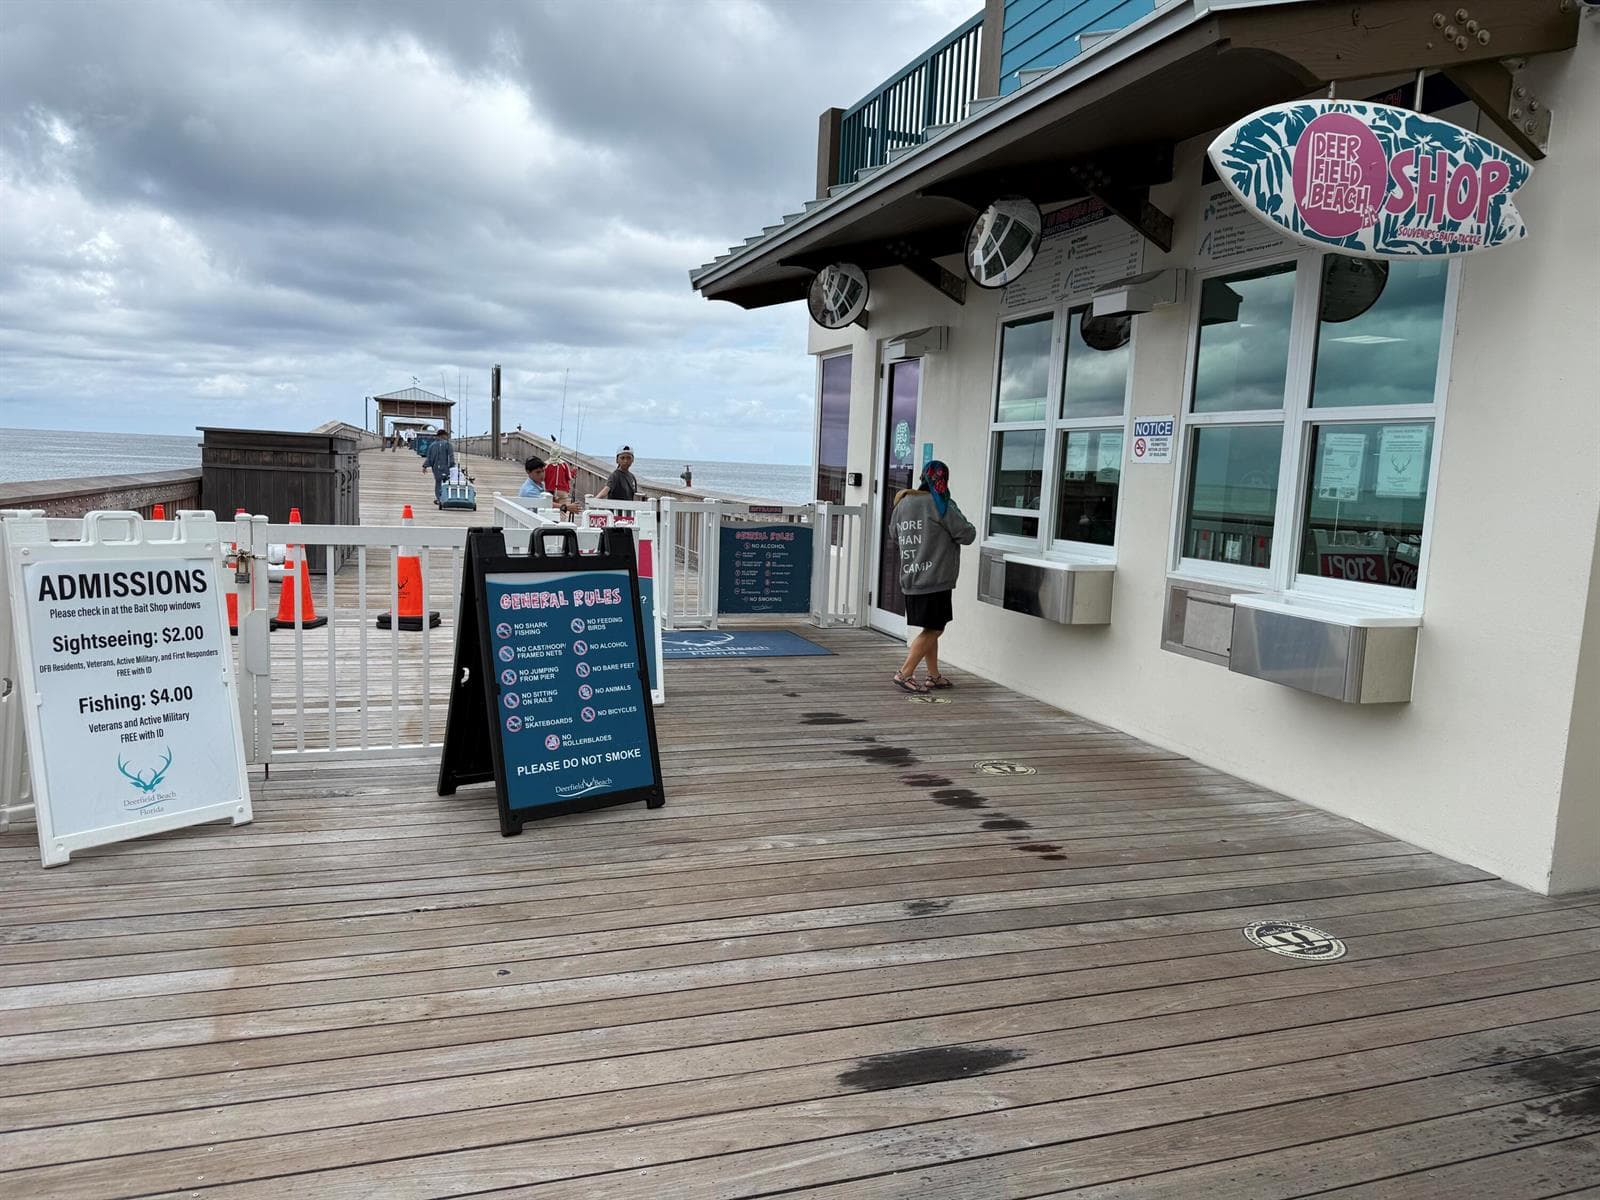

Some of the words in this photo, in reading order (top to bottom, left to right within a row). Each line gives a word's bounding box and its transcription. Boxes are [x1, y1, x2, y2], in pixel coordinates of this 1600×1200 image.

[1314, 132, 1361, 161] DEER
[1312, 158, 1362, 186] FIELD
[1384, 148, 1511, 224] SHOP
[1309, 182, 1370, 214] BEACH
[1135, 422, 1172, 435] NOTICE
[903, 561, 932, 573] CAMP
[38, 569, 208, 602] ADMISSIONS
[500, 590, 569, 610] GENERAL
[573, 588, 622, 607] RULES
[50, 608, 76, 619] Please
[78, 606, 101, 617] check
[102, 606, 110, 615] in
[112, 606, 119, 614] at
[120, 604, 133, 614] the
[134, 603, 149, 613] Bait
[150, 602, 168, 613] Shop
[170, 602, 201, 611] windows
[598, 616, 623, 624] FEEDING
[52, 630, 158, 655] Sightseeing:
[162, 626, 204, 644] $2.00
[53, 660, 86, 672] Residents,
[86, 658, 116, 669] Veterans,
[116, 656, 135, 666] Active
[136, 654, 160, 664] Military,
[161, 653, 172, 661] and
[186, 650, 218, 659] Responders
[117, 669, 131, 677] FREE
[132, 668, 145, 676] with
[146, 666, 152, 674] ID
[530, 666, 559, 675] JUMPING
[533, 690, 558, 698] SITTING
[606, 685, 632, 693] ANIMALS
[79, 694, 146, 714] Fishing:
[150, 686, 193, 706] $4.00
[534, 697, 553, 705] RAILS
[608, 706, 637, 715] BICYCLES
[88, 720, 123, 733] Veterans
[124, 718, 138, 728] and
[139, 714, 162, 726] Active
[162, 712, 190, 723] Military
[525, 717, 573, 729] SKATEBOARDS
[120, 734, 138, 743] FREE
[138, 731, 156, 741] with
[156, 728, 164, 738] ID
[562, 734, 612, 747] ROLLERBLADES
[517, 760, 561, 777] PLEASE
[563, 758, 579, 769] DO
[582, 754, 603, 766] NOT
[606, 748, 641, 762] SMOKE
[555, 782, 585, 793] Deerfield
[594, 778, 613, 786] Beach
[124, 794, 155, 807] Deerfield
[157, 792, 177, 800] Beach
[140, 807, 164, 816] Florida
